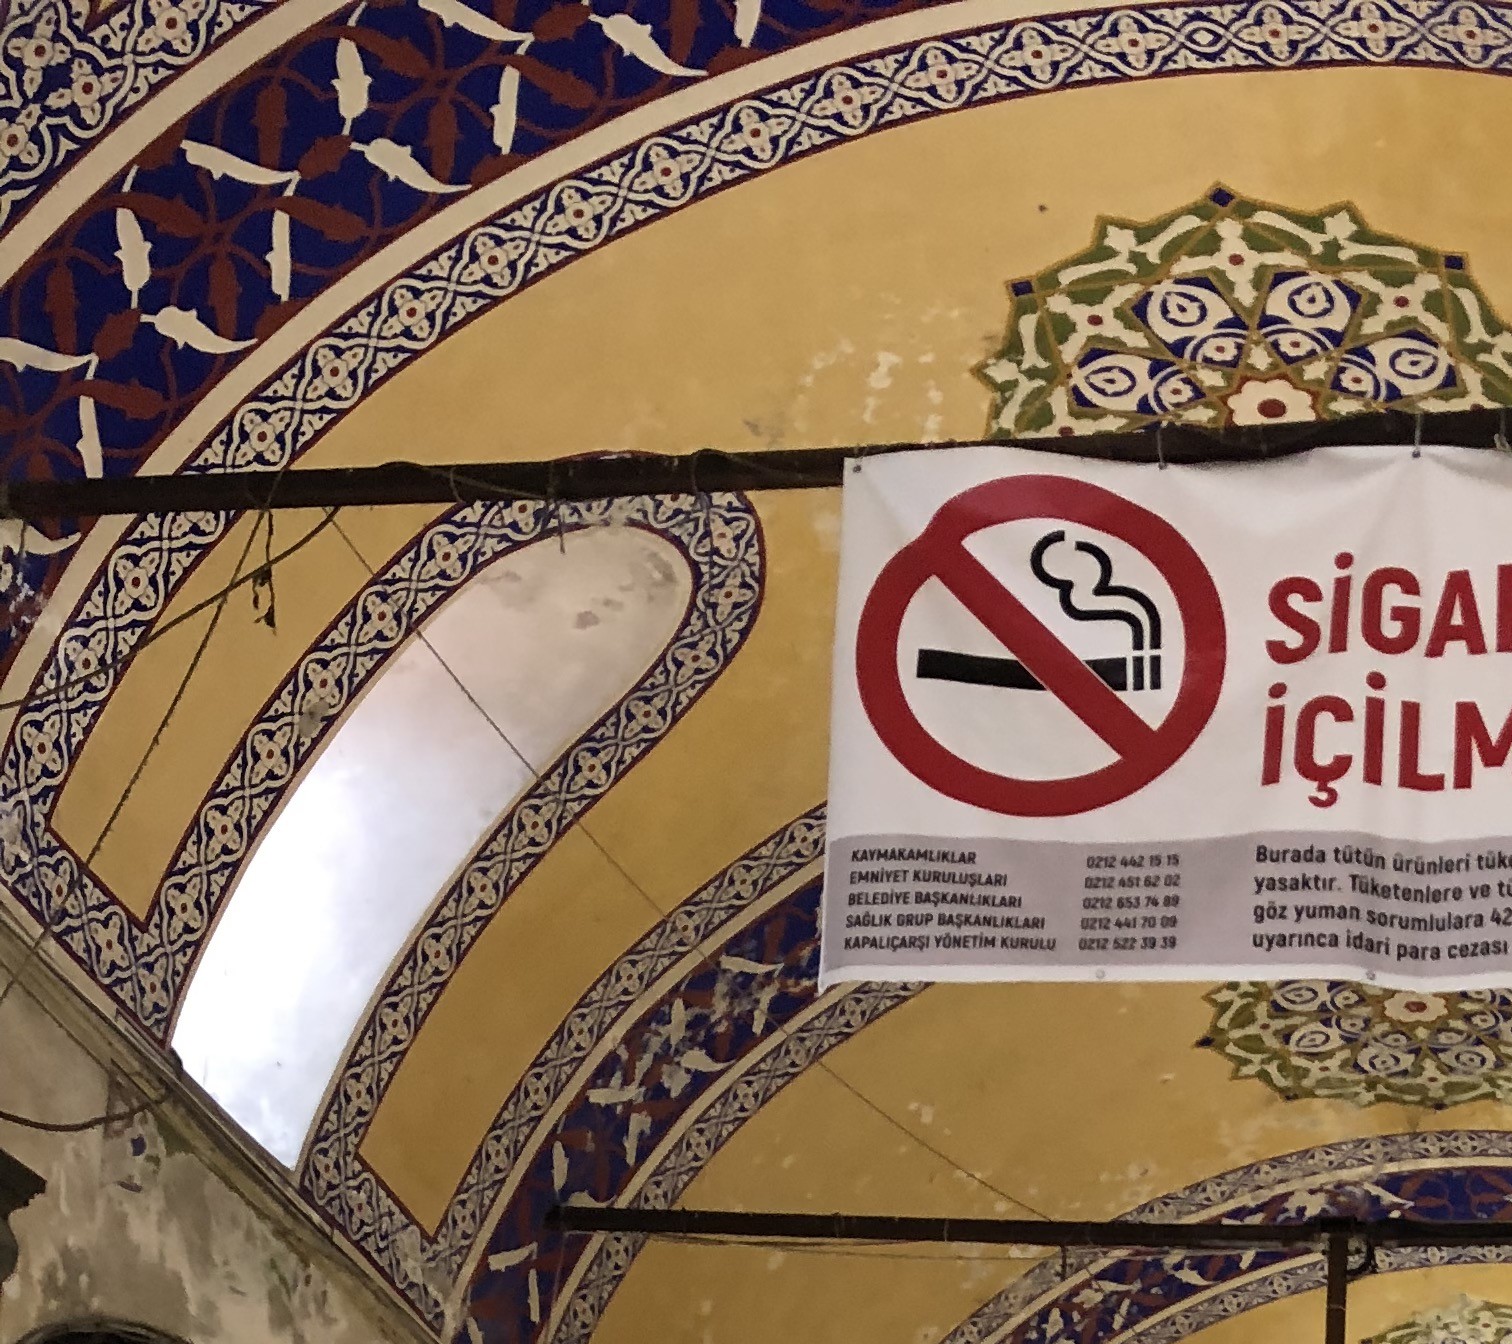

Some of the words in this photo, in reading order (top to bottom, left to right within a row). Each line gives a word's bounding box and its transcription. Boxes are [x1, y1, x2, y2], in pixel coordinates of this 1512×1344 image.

[851, 848, 977, 865] KAYMAKAMLIKLAR
[1086, 855, 1117, 869] 0212
[1256, 844, 1326, 864] Burada
[1333, 845, 1386, 870] tütün
[1392, 848, 1470, 875] ürünleri
[849, 867, 910, 884] EMNİYET
[912, 870, 1008, 888] KURULUŞLARI
[1084, 876, 1116, 889] 0212
[1253, 873, 1343, 895] yasaktır.
[1348, 873, 1462, 903] Tüketenlere
[1469, 883, 1490, 899] ve
[847, 889, 911, 906] BELEDİYE
[914, 891, 1022, 908] BAŞKANLIKLARI
[1082, 896, 1115, 910] 0212
[845, 912, 892, 929] SAĞLIK
[896, 914, 934, 927] GRUP
[937, 914, 1045, 930] BAŞKANLIKLARI
[1080, 917, 1111, 930] 0212
[1253, 901, 1288, 922] göz
[1294, 903, 1360, 923] yuman
[1366, 907, 1485, 932] sorumlulara
[844, 935, 929, 953] KAPALIÇARŞI
[934, 931, 996, 950] YÖNETİM
[1000, 936, 1057, 951] KURULU
[1078, 937, 1109, 951] 0212
[1252, 929, 1339, 950] uyarınca
[1345, 929, 1390, 955] idari
[1397, 942, 1441, 961] para
[1447, 939, 1509, 960] cezası
